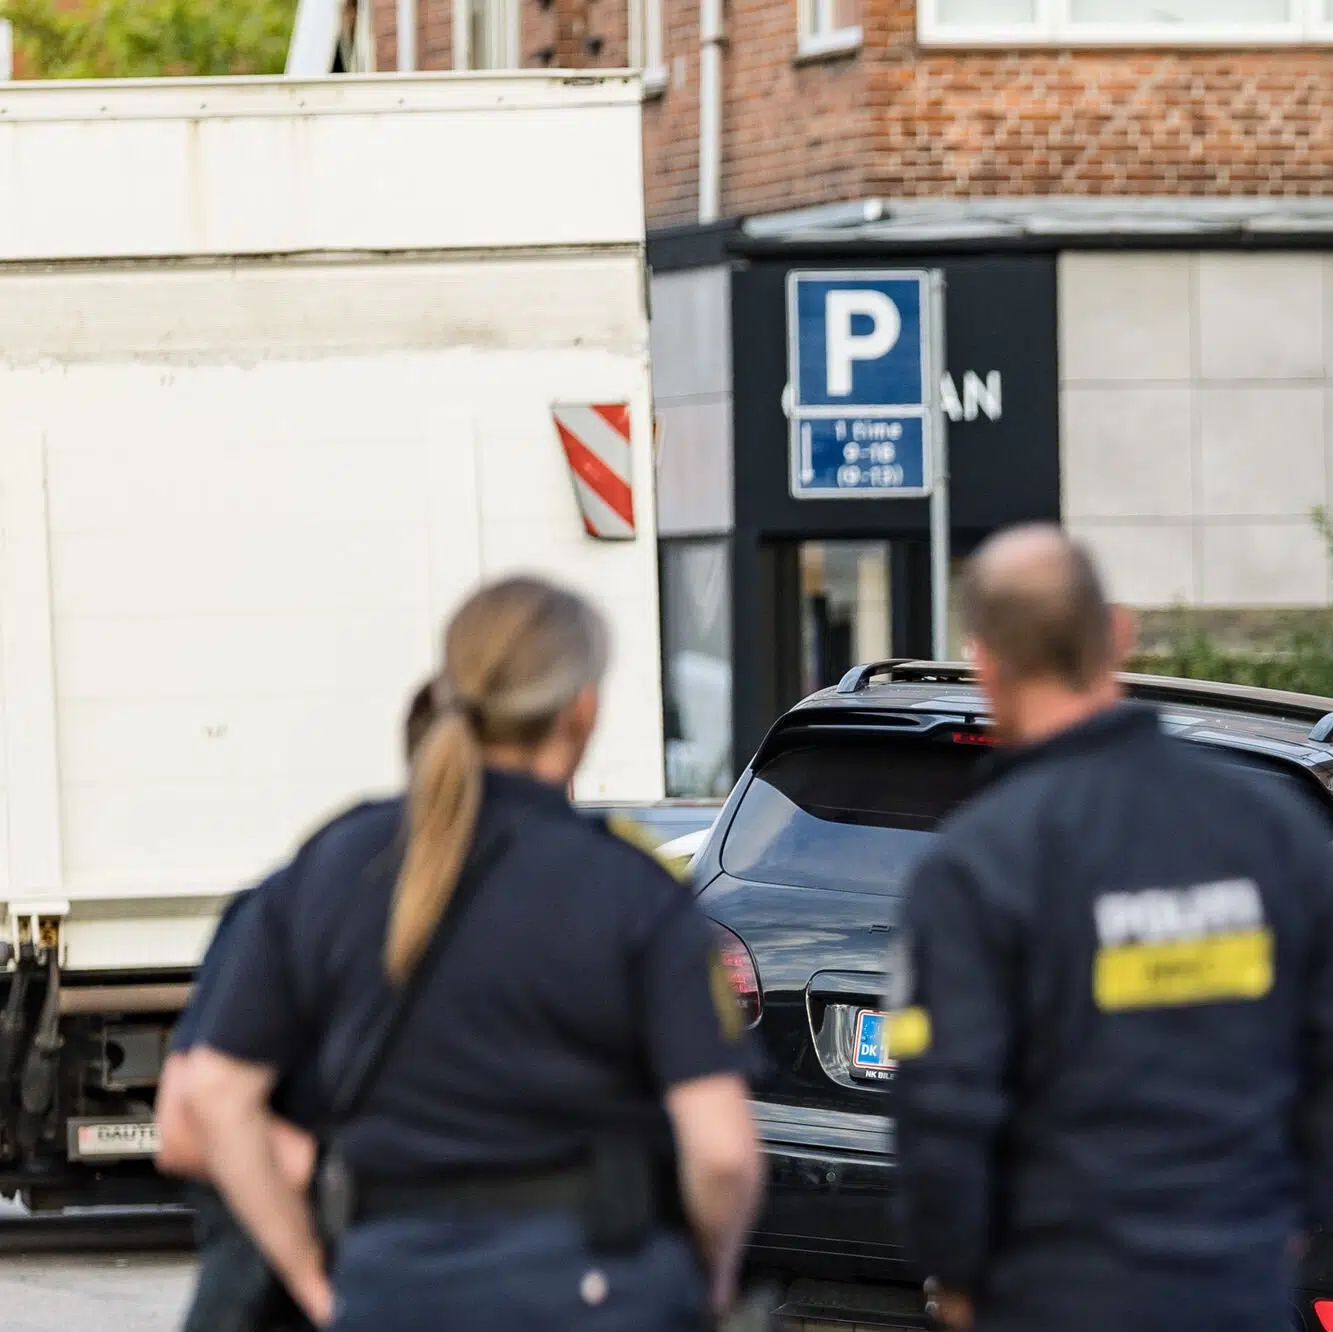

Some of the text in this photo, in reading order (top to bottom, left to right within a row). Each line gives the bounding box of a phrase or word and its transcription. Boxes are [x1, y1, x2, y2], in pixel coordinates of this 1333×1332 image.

[825, 289, 901, 396] P
[835, 420, 847, 441] 1
[861, 1044, 878, 1057] DK
[866, 1070, 878, 1079] NK
[97, 1125, 160, 1141] DAUTE
